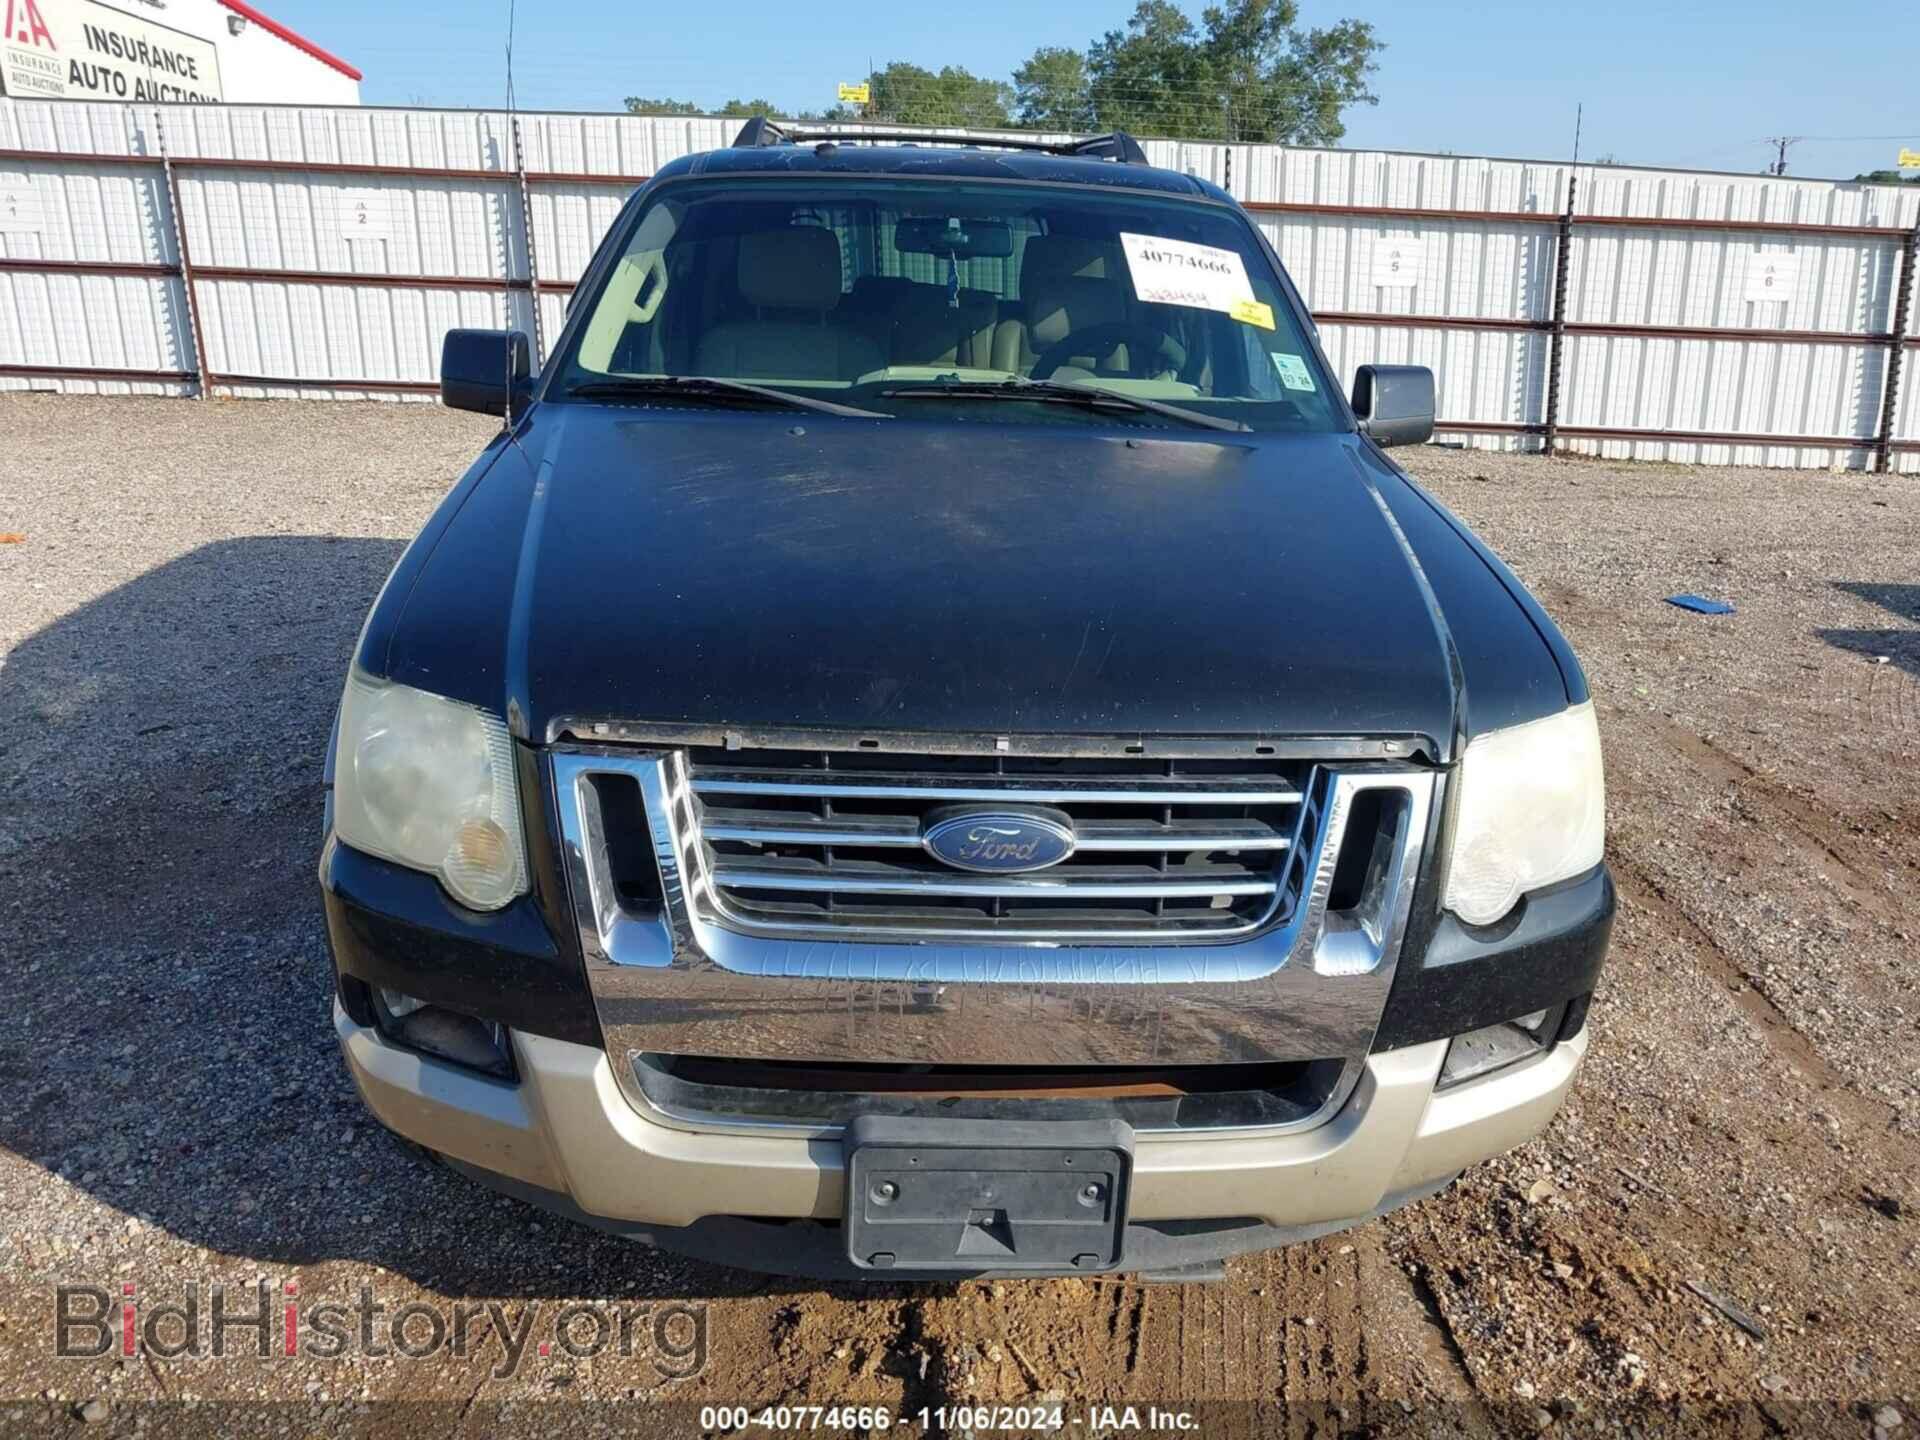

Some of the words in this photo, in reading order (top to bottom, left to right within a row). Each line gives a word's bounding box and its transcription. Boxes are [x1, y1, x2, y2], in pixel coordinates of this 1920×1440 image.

[83, 23, 199, 81] INSURANCE
[69, 58, 127, 97] AUTO
[358, 213, 367, 225] 2
[1139, 247, 1232, 275] 40774666
[1391, 260, 1400, 272] 5
[1764, 276, 1774, 288] 6
[959, 826, 1040, 860] Ford
